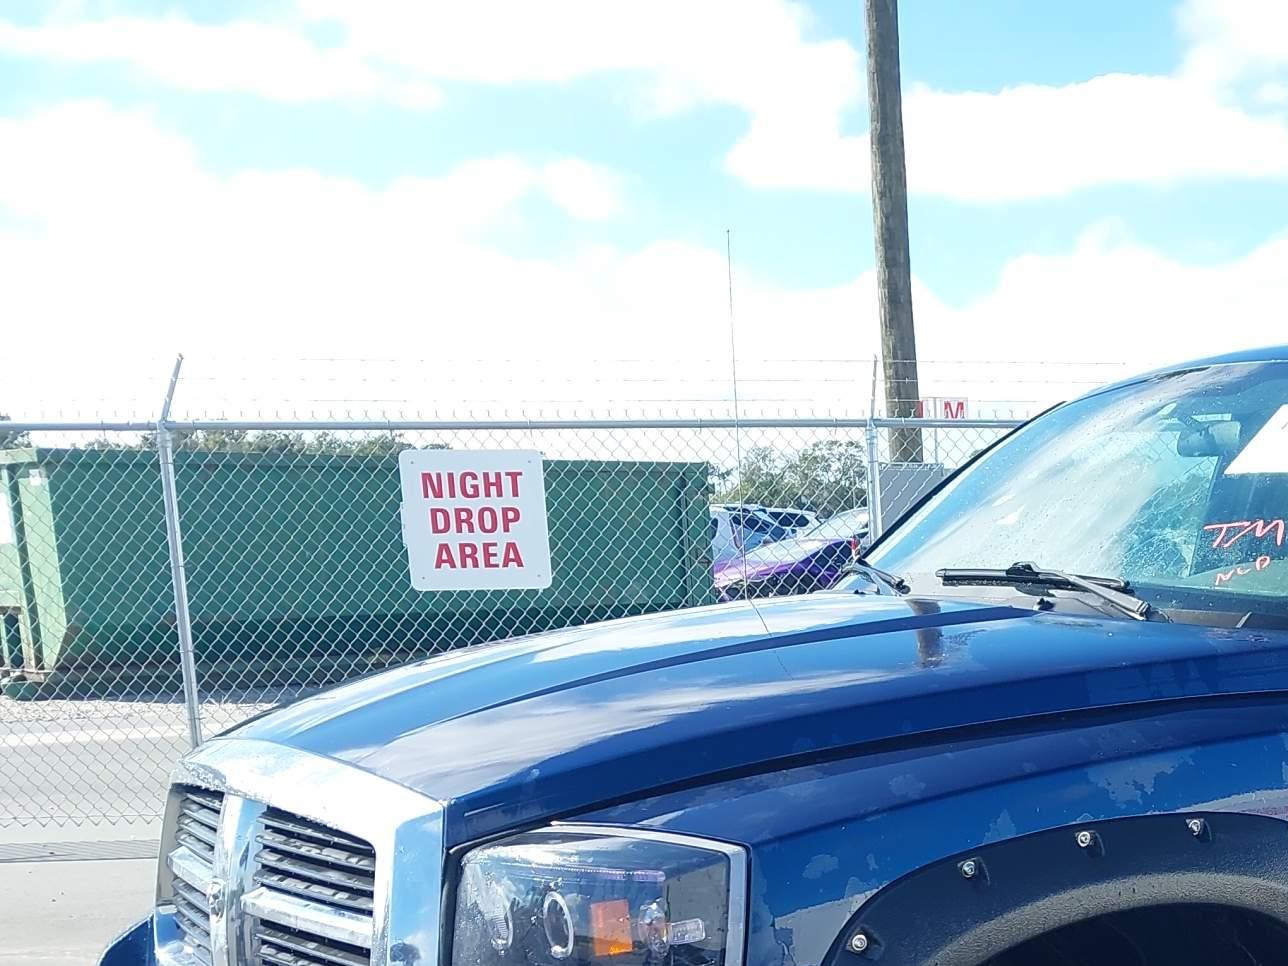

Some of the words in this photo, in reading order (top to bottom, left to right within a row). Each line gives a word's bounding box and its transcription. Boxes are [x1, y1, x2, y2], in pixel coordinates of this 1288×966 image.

[421, 471, 523, 499] NIGHT
[430, 507, 521, 534] DROP
[434, 542, 524, 569] AREA
